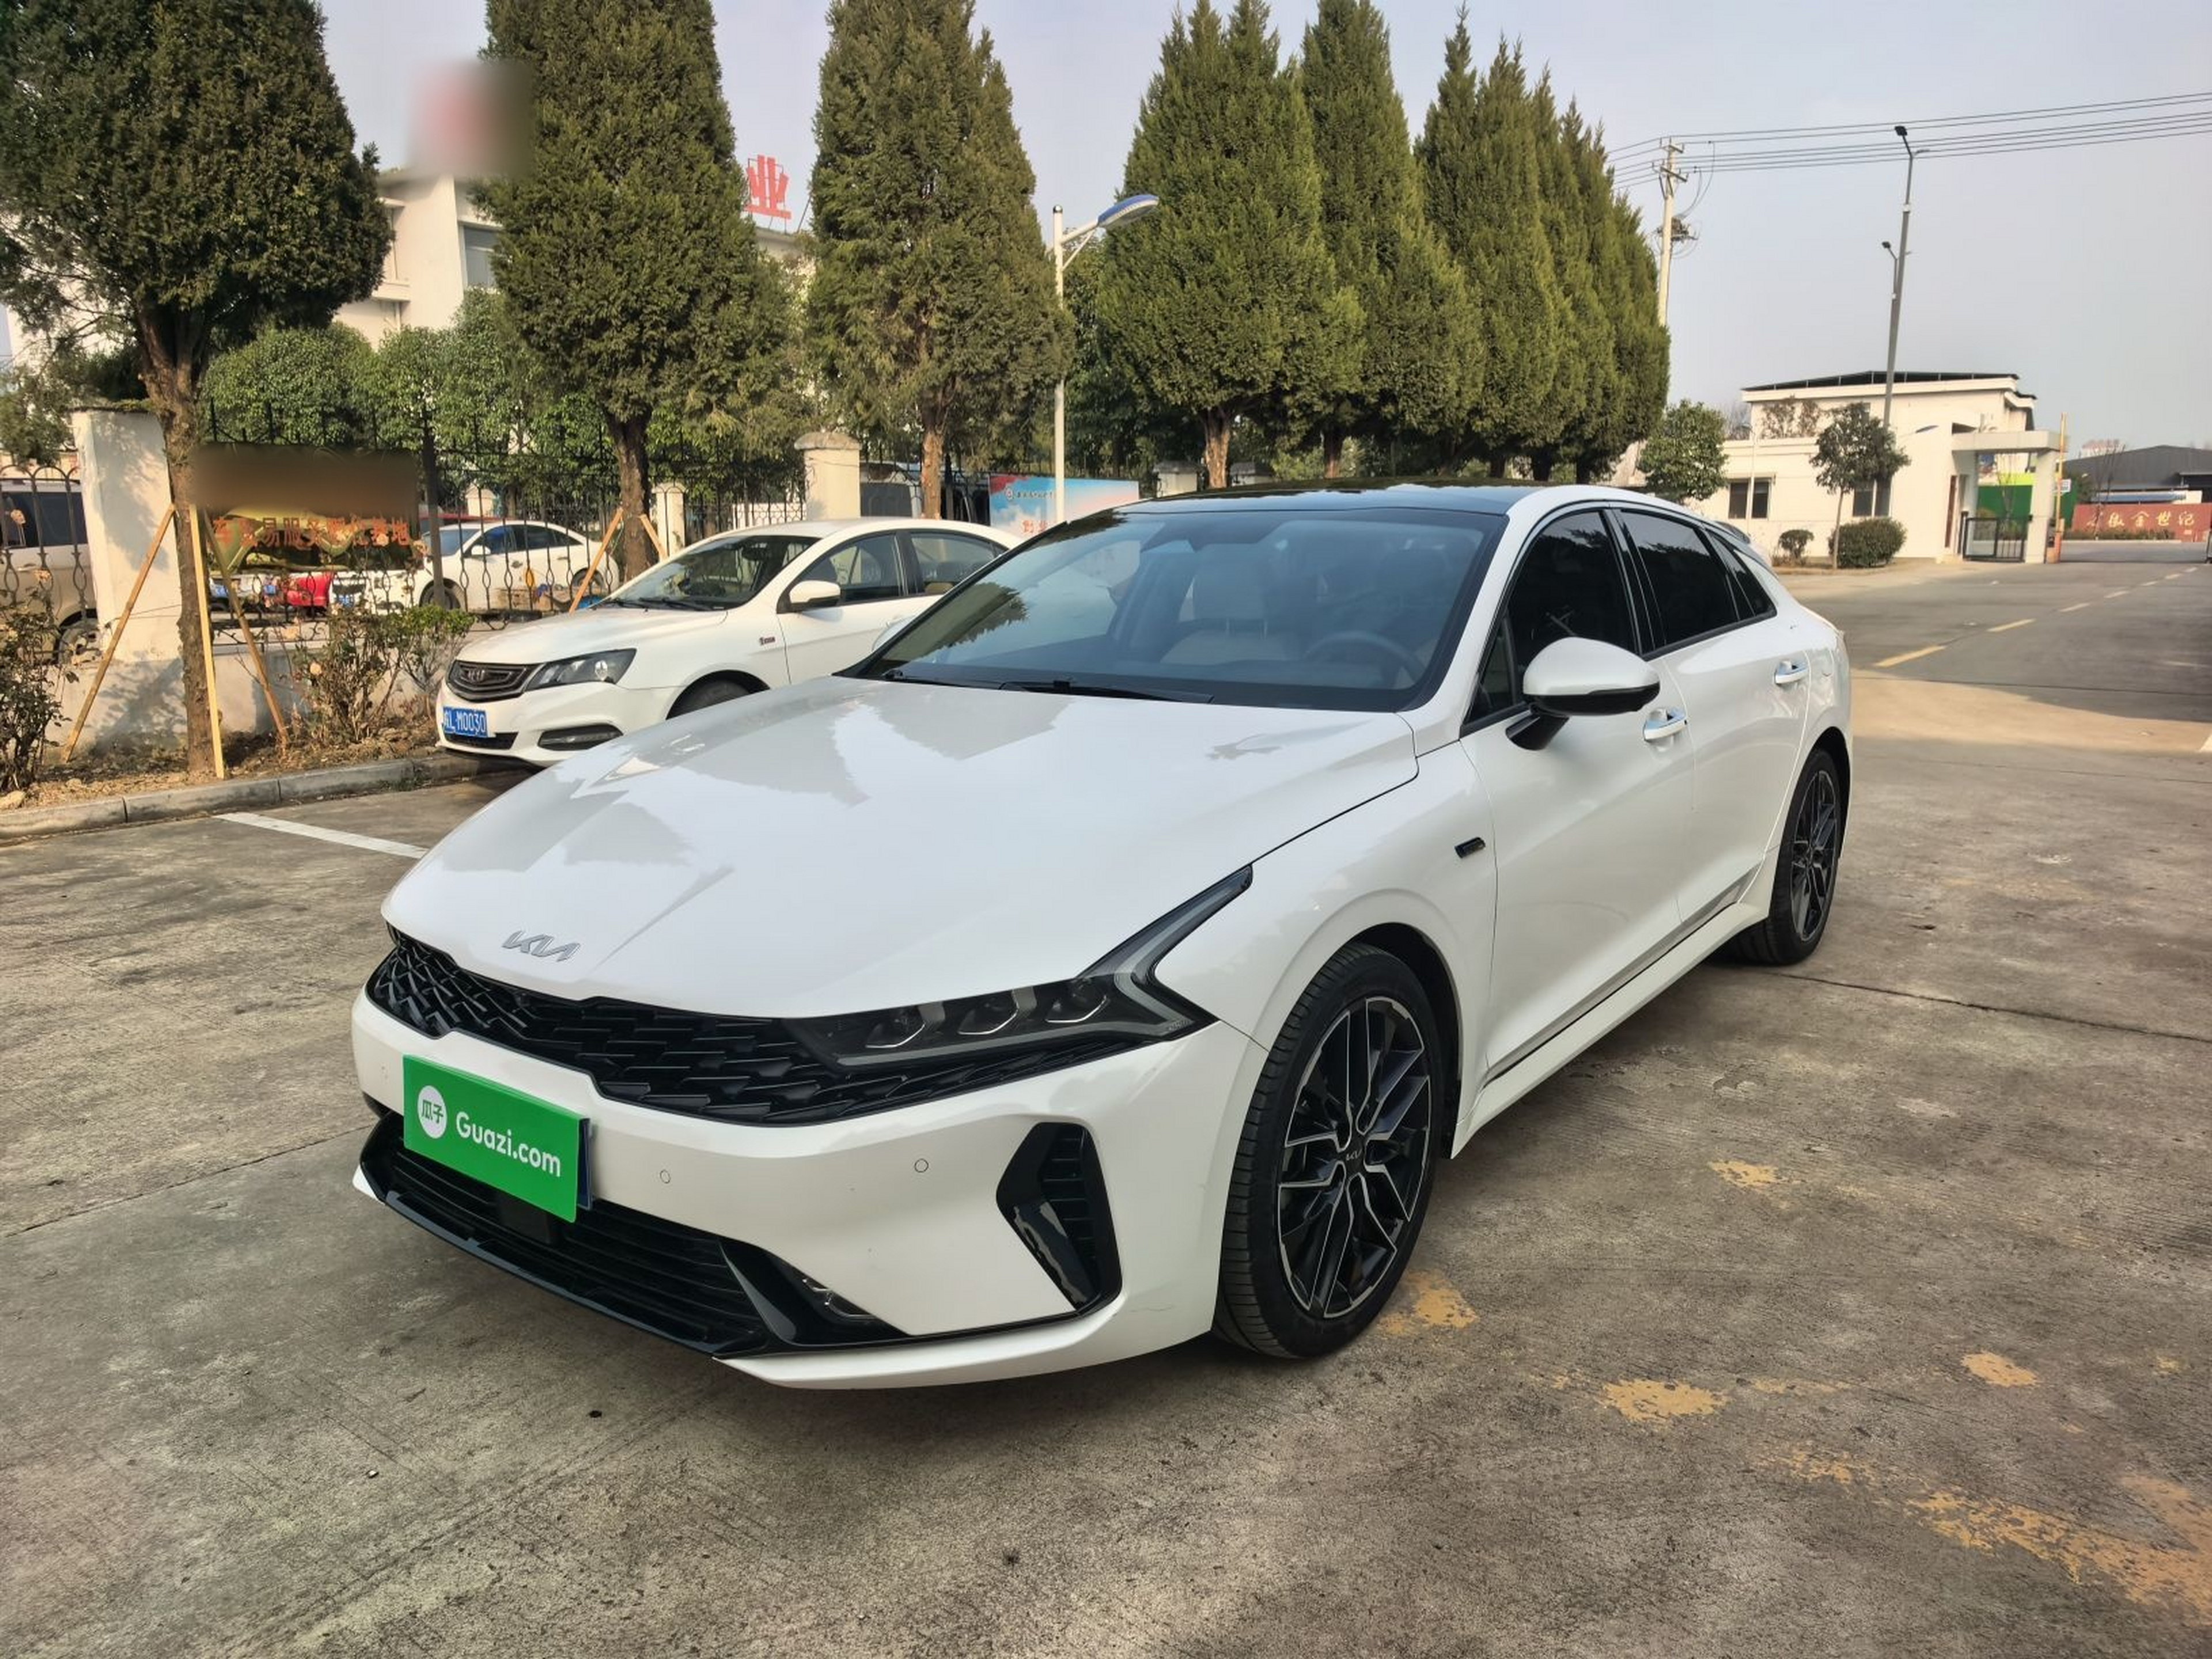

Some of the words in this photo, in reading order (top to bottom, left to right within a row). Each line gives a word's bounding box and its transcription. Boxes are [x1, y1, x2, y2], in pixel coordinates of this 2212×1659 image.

[745, 154, 791, 219] 业
[502, 930, 581, 962] KIA
[421, 1099, 444, 1124] 瓜子
[456, 1111, 561, 1177] Guazi.com
